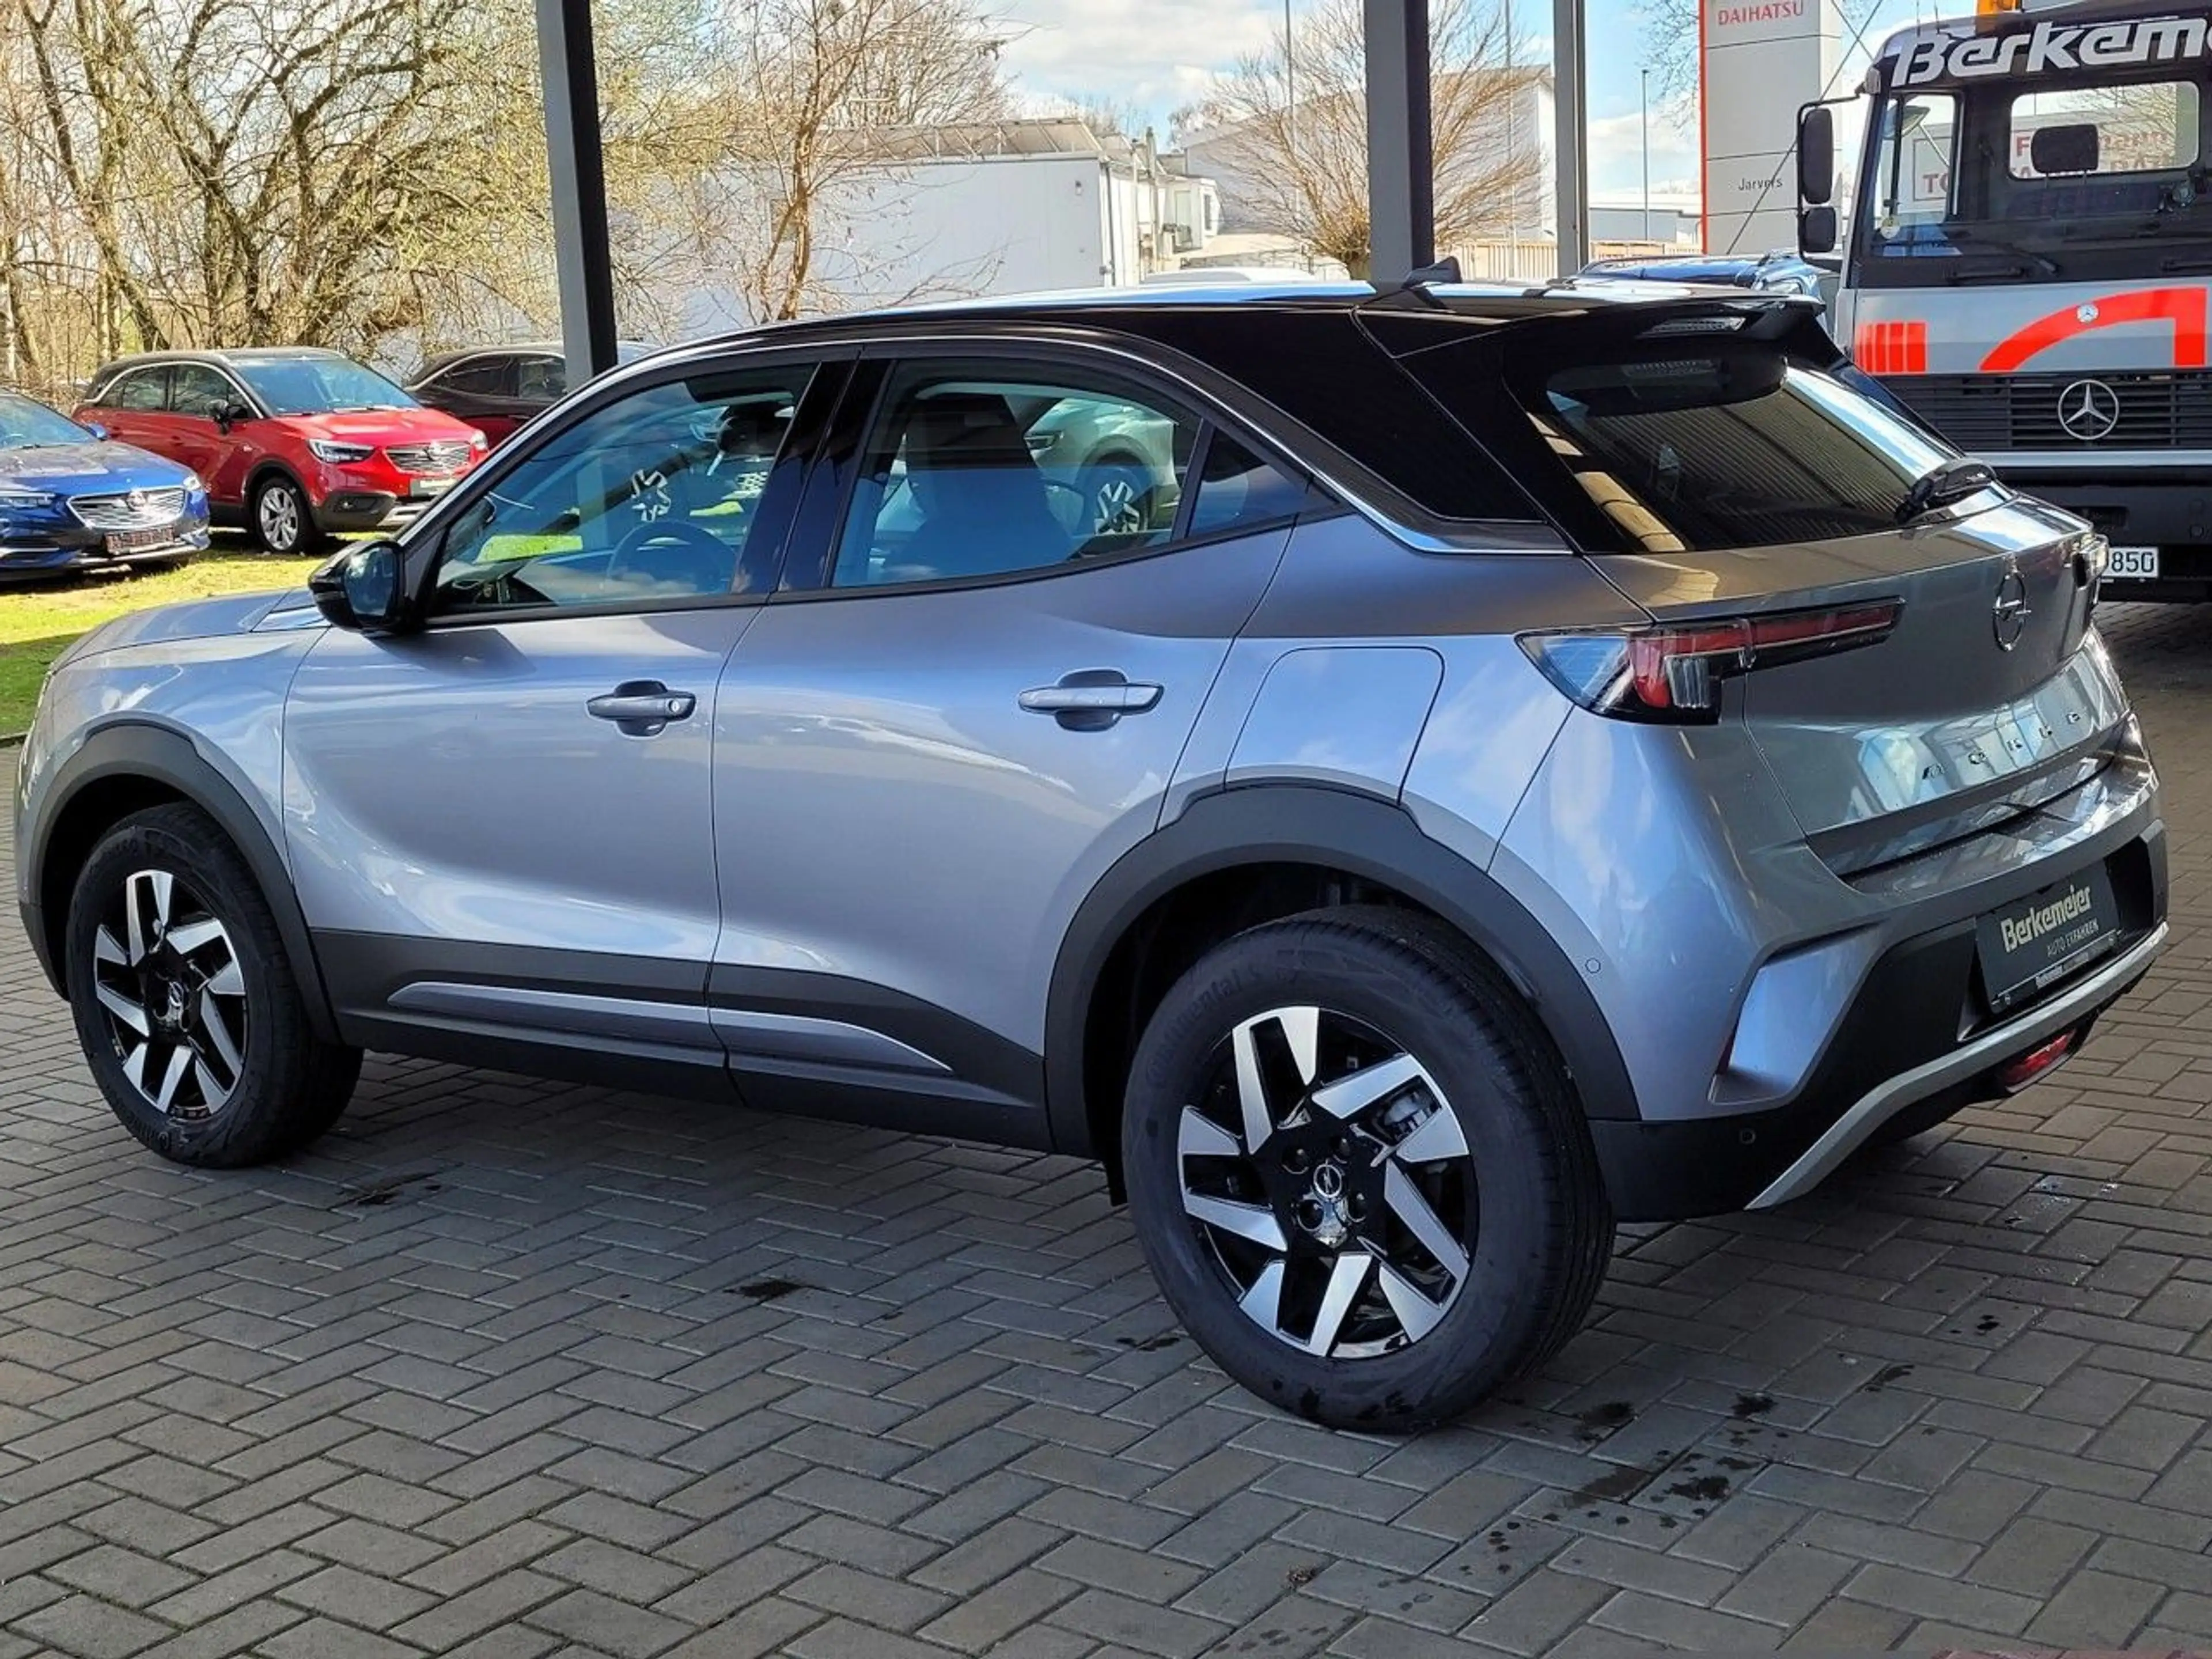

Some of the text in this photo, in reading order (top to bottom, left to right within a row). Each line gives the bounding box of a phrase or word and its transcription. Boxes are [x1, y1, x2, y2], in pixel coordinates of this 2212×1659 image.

[1718, 0, 1804, 26] DAIHATSU
[1891, 18, 2212, 88] Berkem
[2111, 551, 2155, 573] 850
[2000, 884, 2091, 953] Berkemeier
